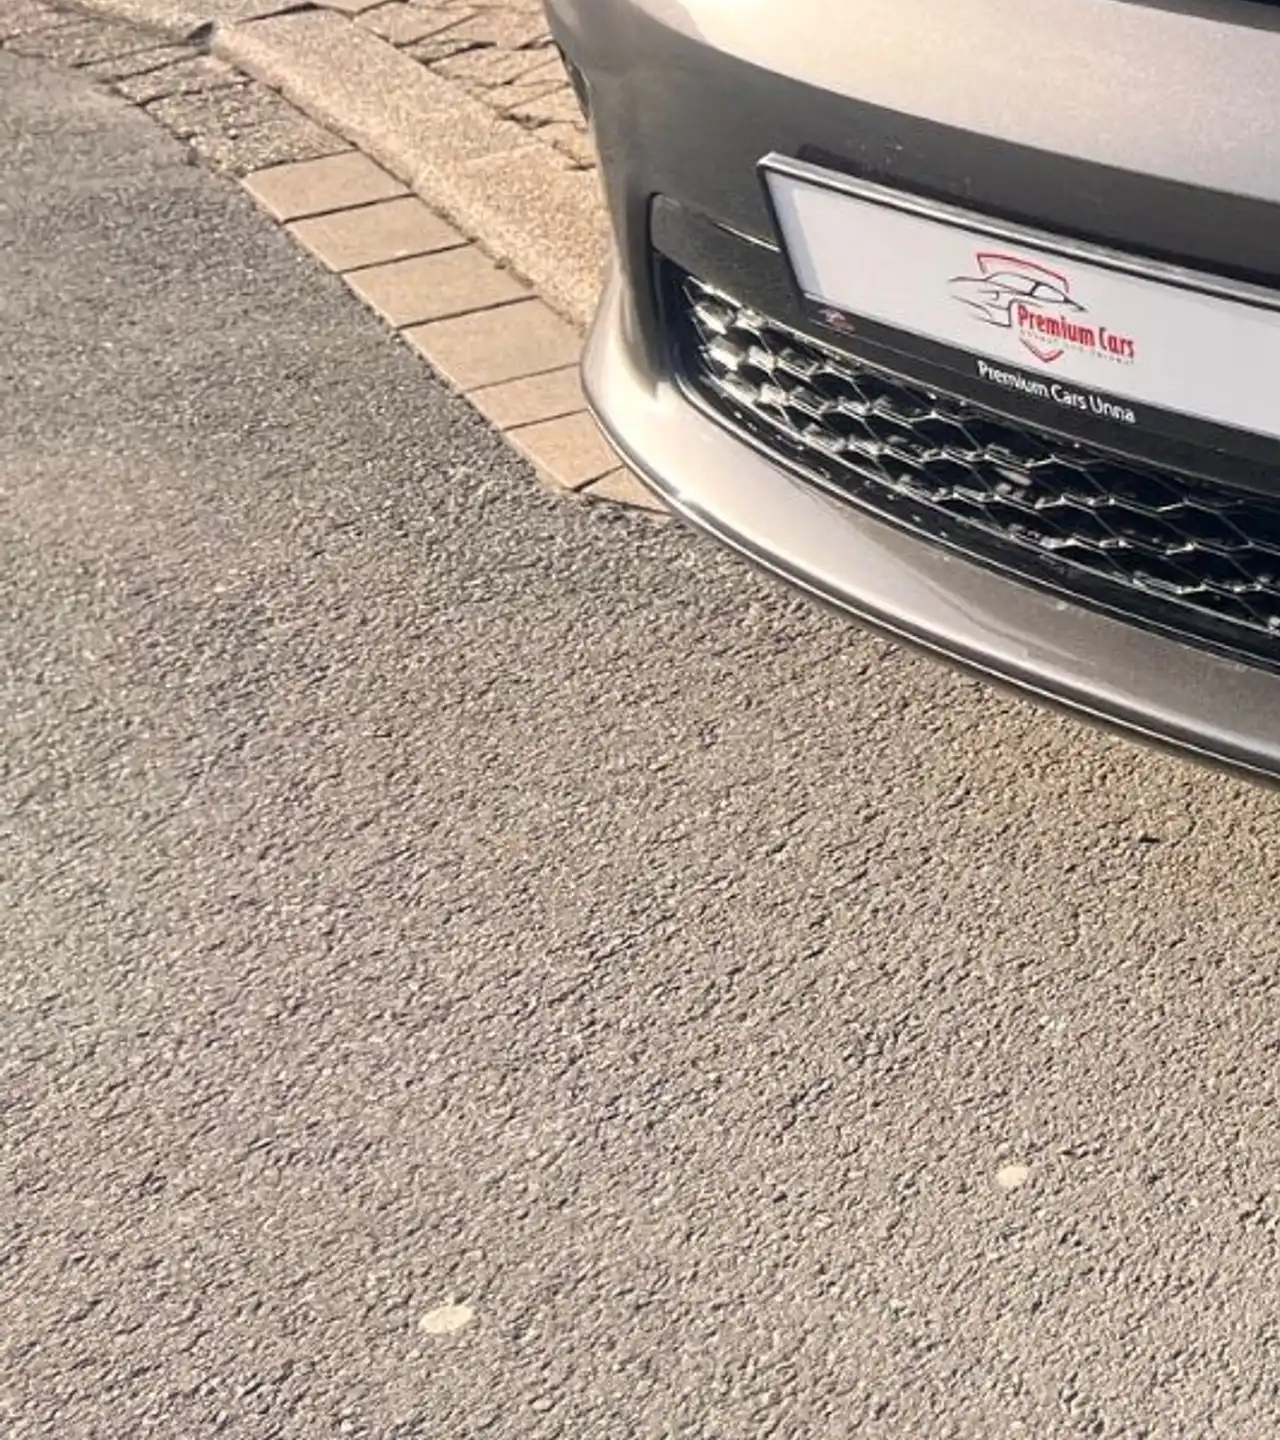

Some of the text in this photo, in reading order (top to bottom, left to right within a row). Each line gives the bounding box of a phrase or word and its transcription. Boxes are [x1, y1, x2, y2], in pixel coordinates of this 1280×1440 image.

[1017, 303, 1095, 347] Premium
[1098, 326, 1135, 358] Cars
[976, 359, 1137, 424] Premium Cars Unna
